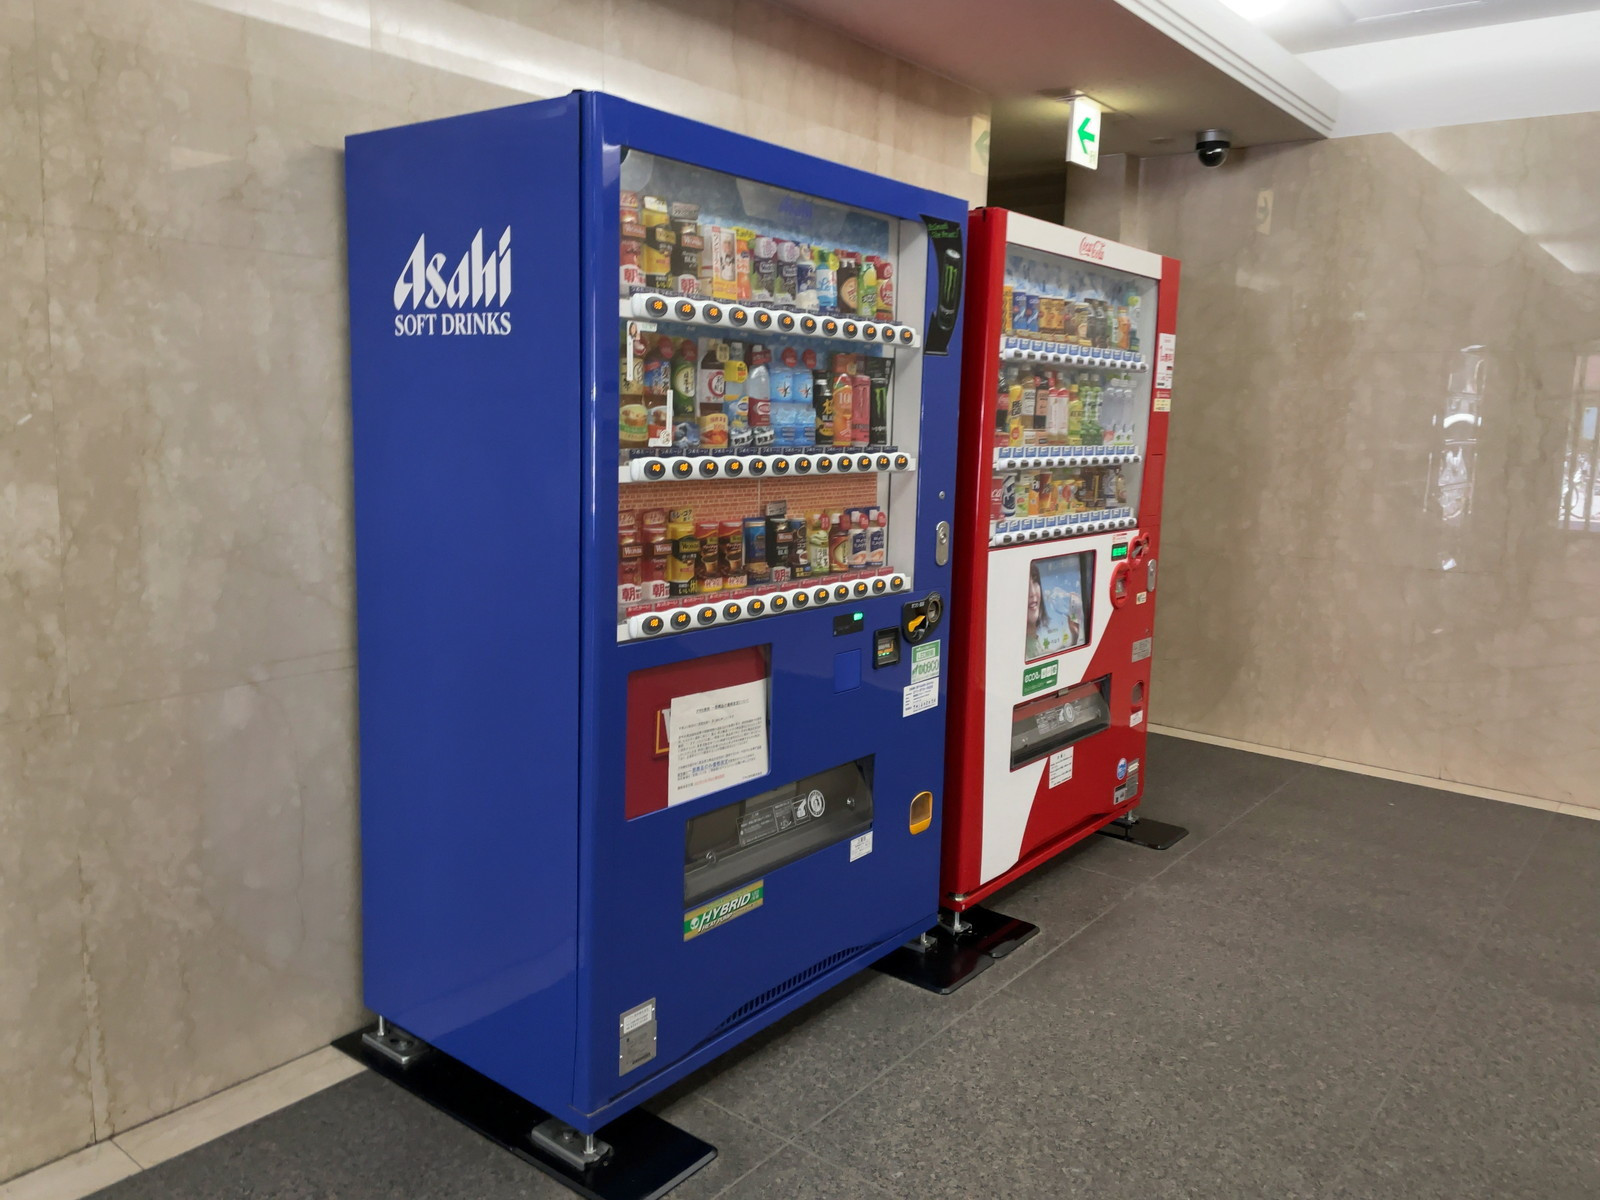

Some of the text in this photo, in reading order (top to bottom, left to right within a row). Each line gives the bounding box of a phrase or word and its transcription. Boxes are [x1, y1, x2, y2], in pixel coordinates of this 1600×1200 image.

[394, 224, 511, 311] Asahi
[394, 311, 512, 337] SOFT DRINKS
[698, 892, 751, 932] HYBRID
